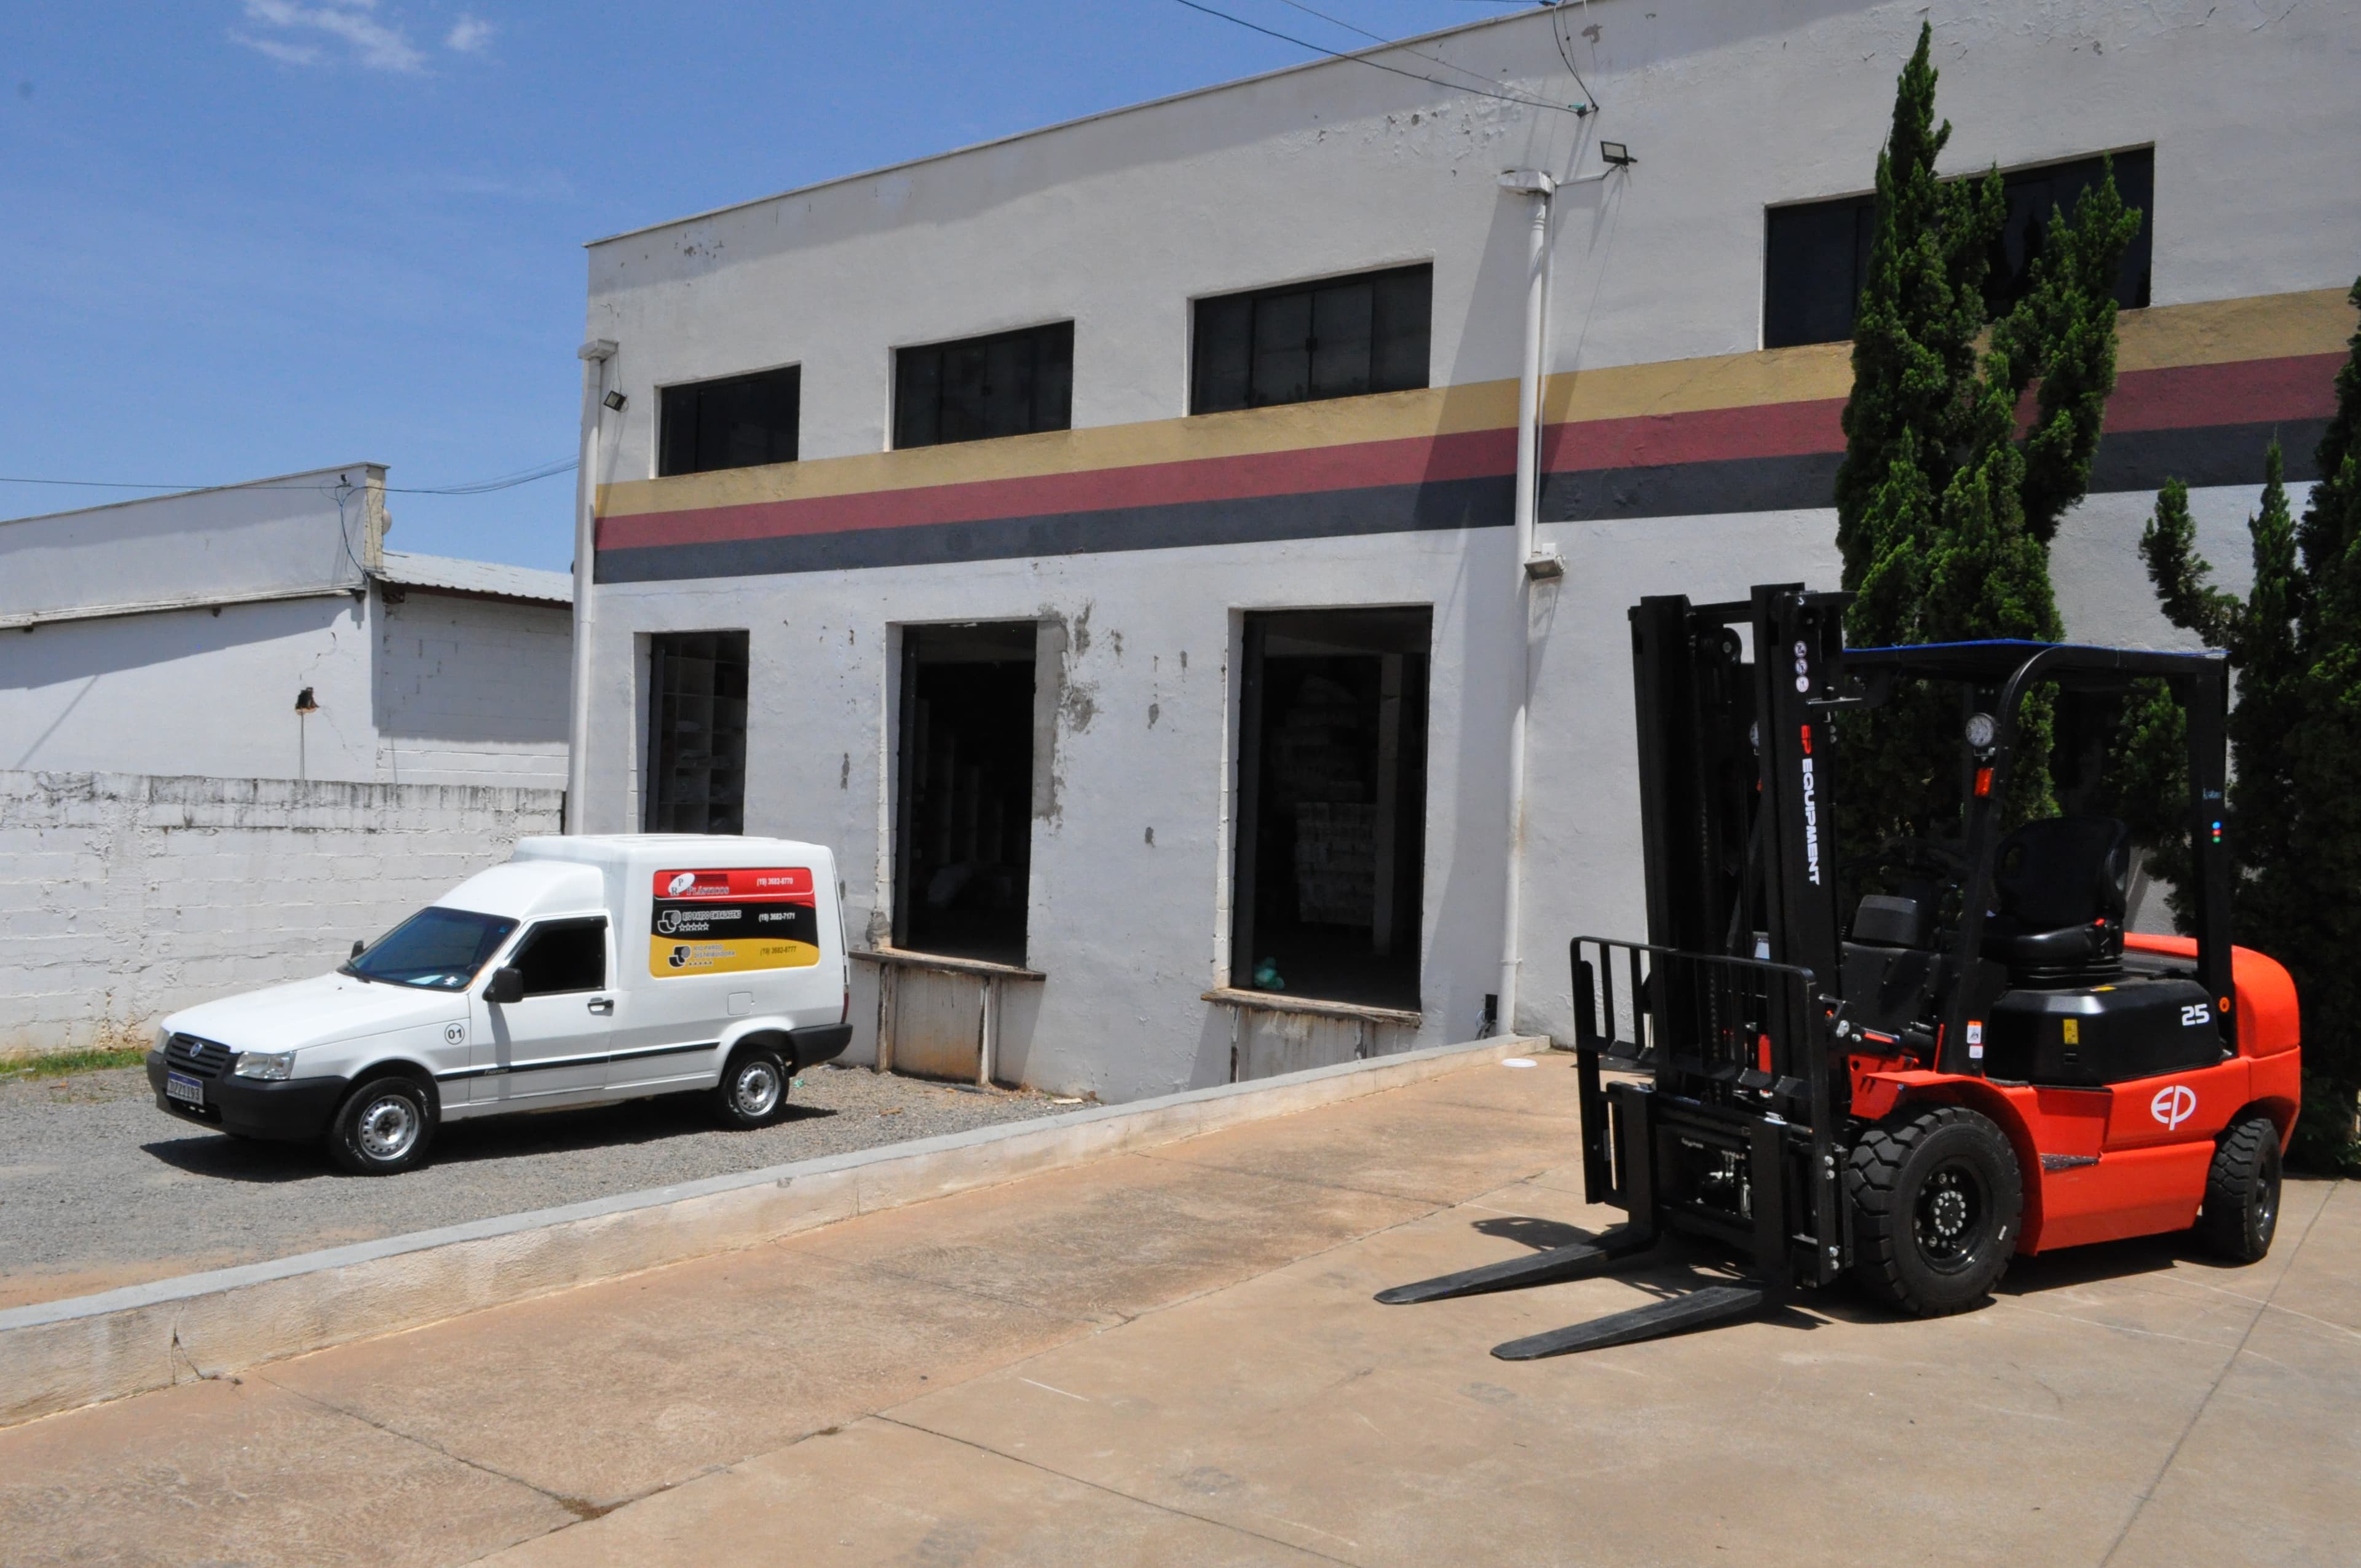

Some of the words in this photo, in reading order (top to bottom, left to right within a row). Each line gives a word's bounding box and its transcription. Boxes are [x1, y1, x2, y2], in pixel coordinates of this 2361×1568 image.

[1802, 758, 1820, 885] EQUIPMENT
[2181, 1003, 2210, 1026] 25
[448, 1028, 462, 1040] 01
[2151, 1085, 2197, 1131] EP
